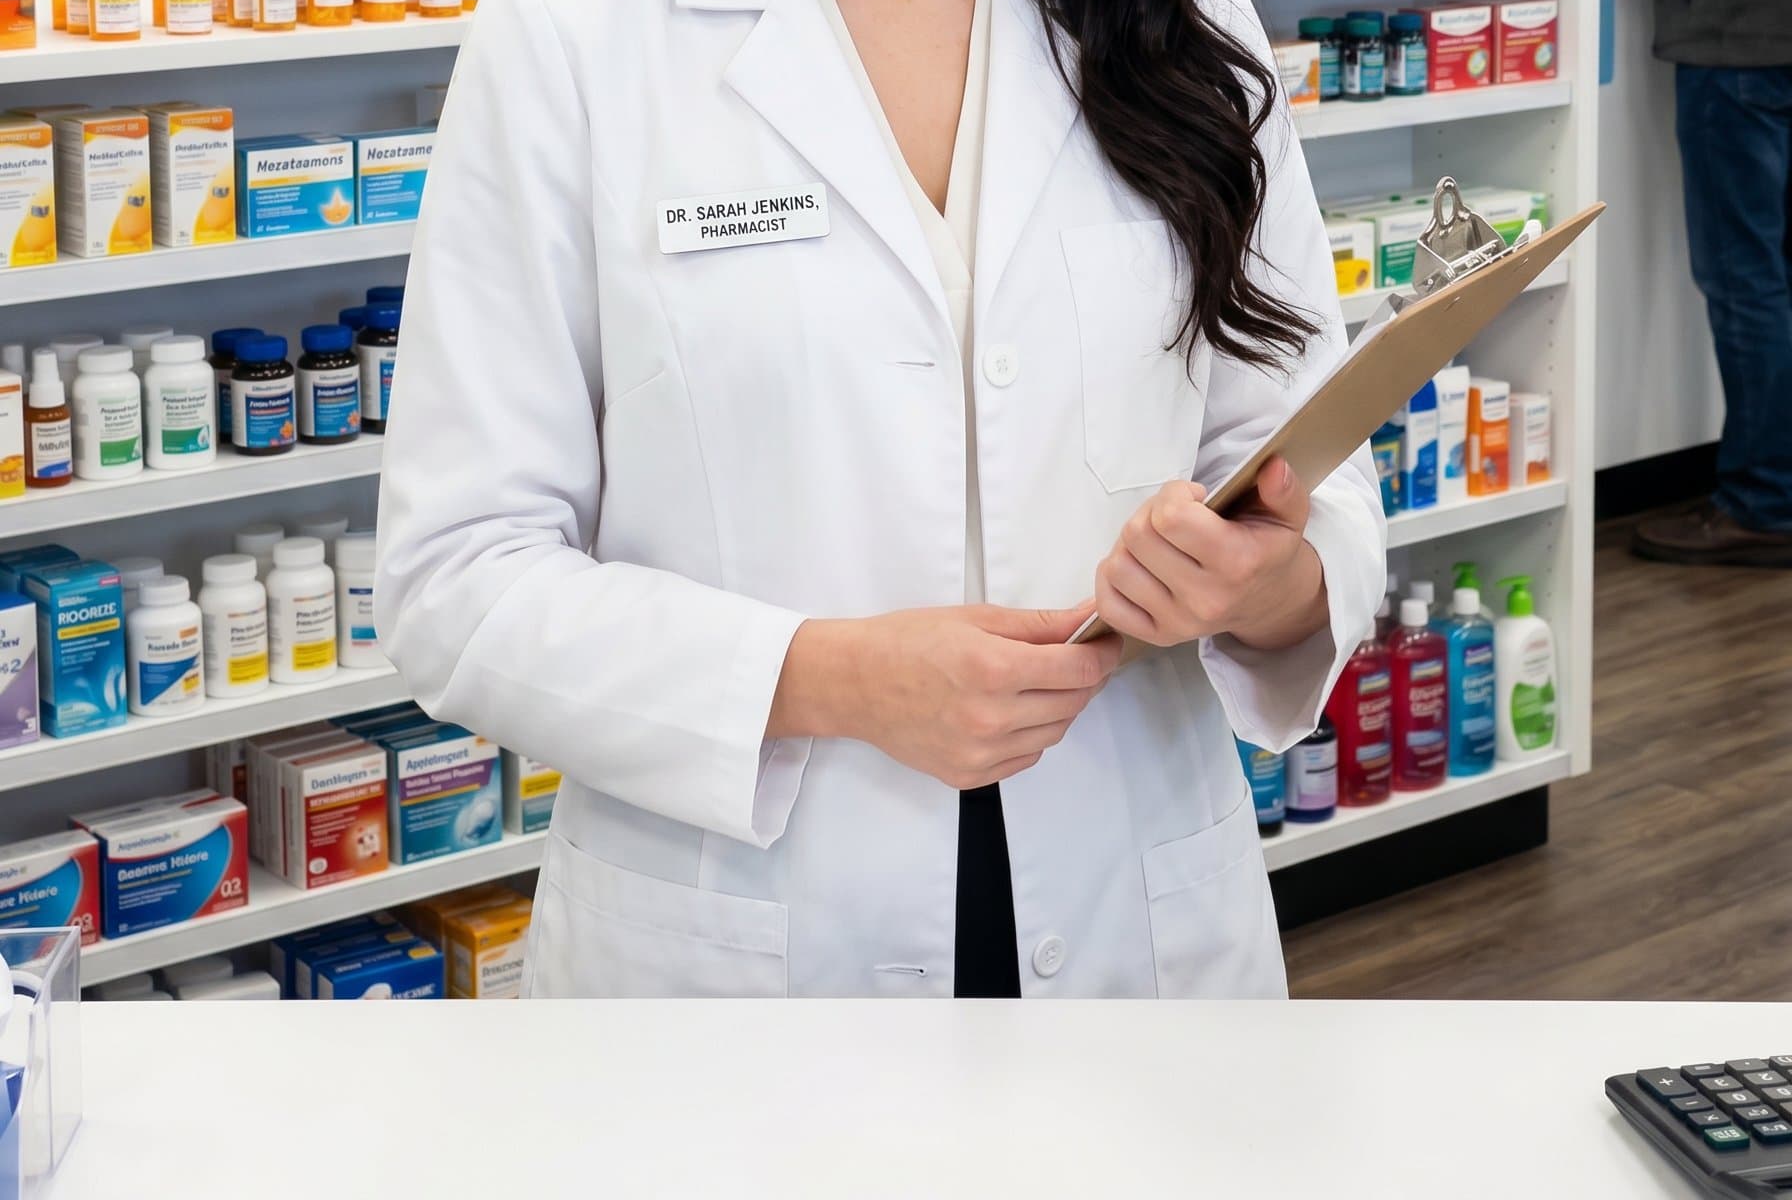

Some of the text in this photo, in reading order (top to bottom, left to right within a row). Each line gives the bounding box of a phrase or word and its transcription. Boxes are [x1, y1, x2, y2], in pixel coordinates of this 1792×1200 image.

[666, 194, 819, 224] DR. SARAH JENKINS,
[701, 217, 787, 239] PHARMACIST
